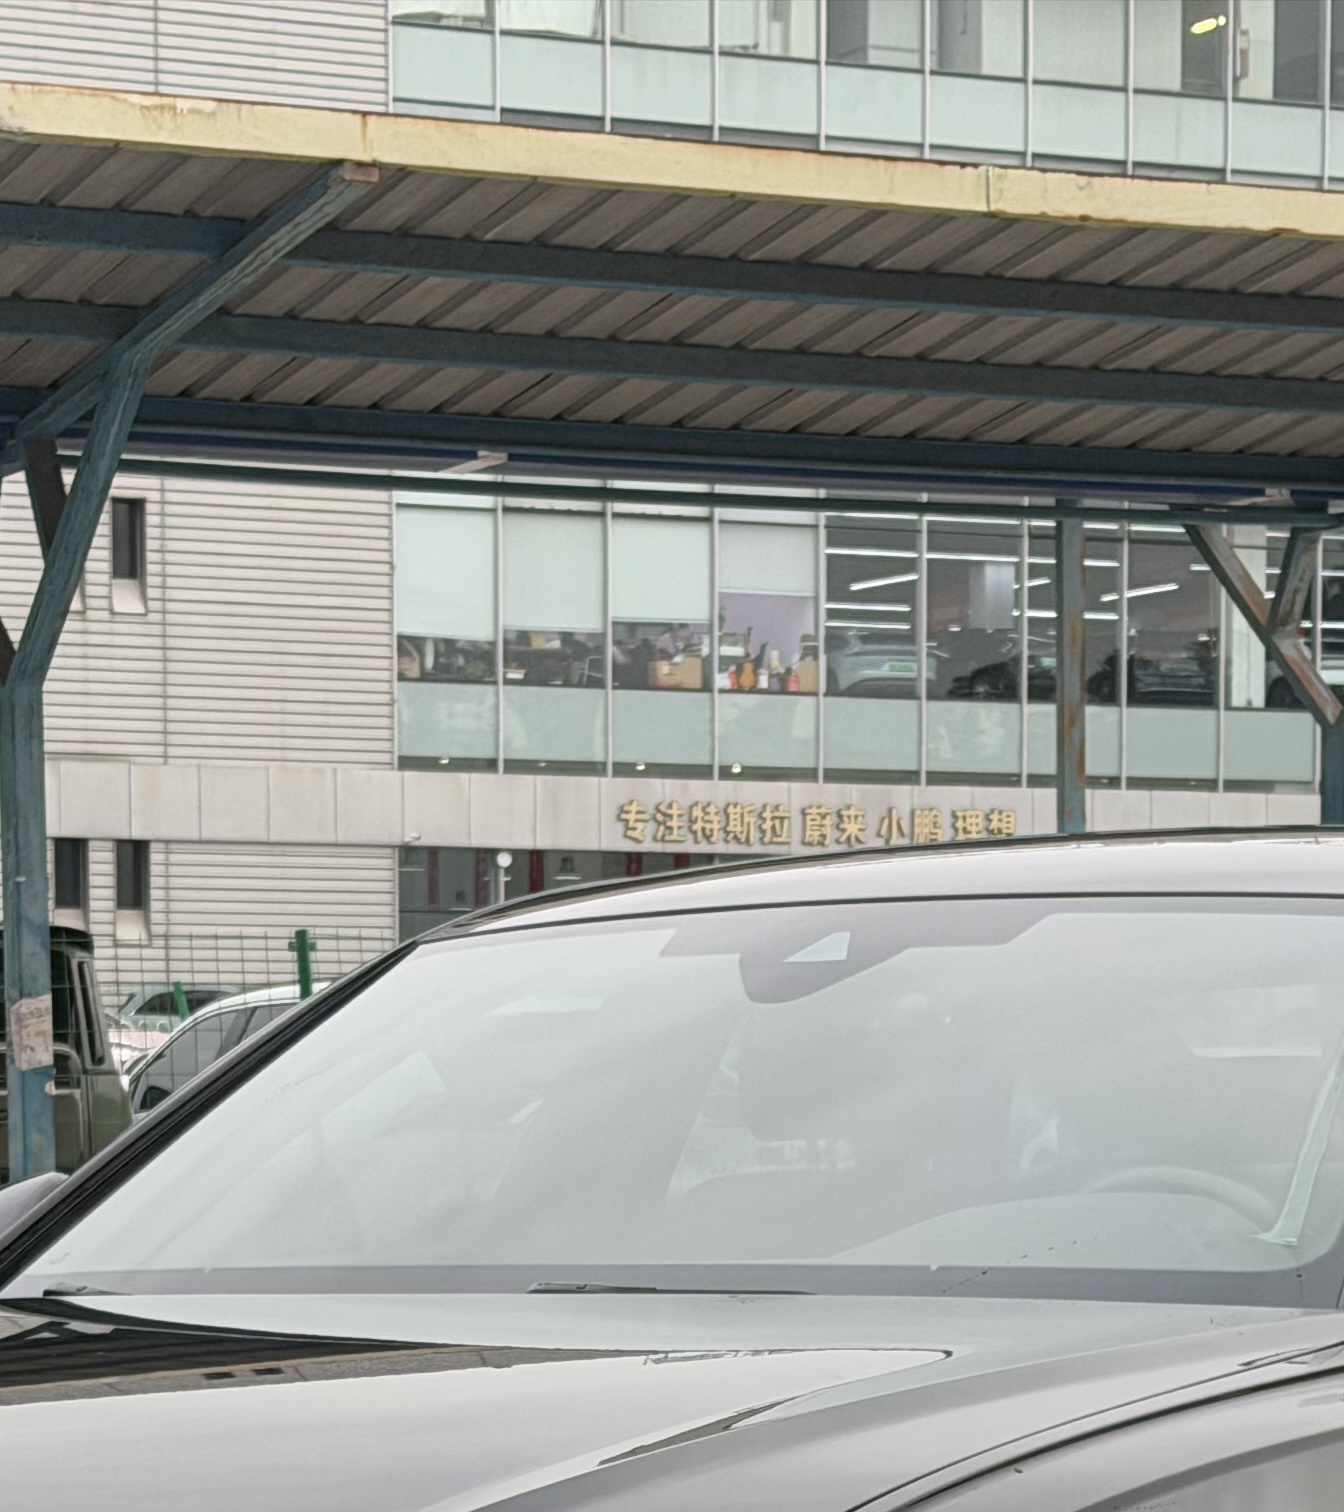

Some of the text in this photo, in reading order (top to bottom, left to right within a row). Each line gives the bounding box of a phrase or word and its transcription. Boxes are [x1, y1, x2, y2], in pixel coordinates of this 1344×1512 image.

[619, 800, 791, 845] 专注特斯拉
[801, 805, 869, 846] 蔚来
[878, 807, 943, 844] 小鹏
